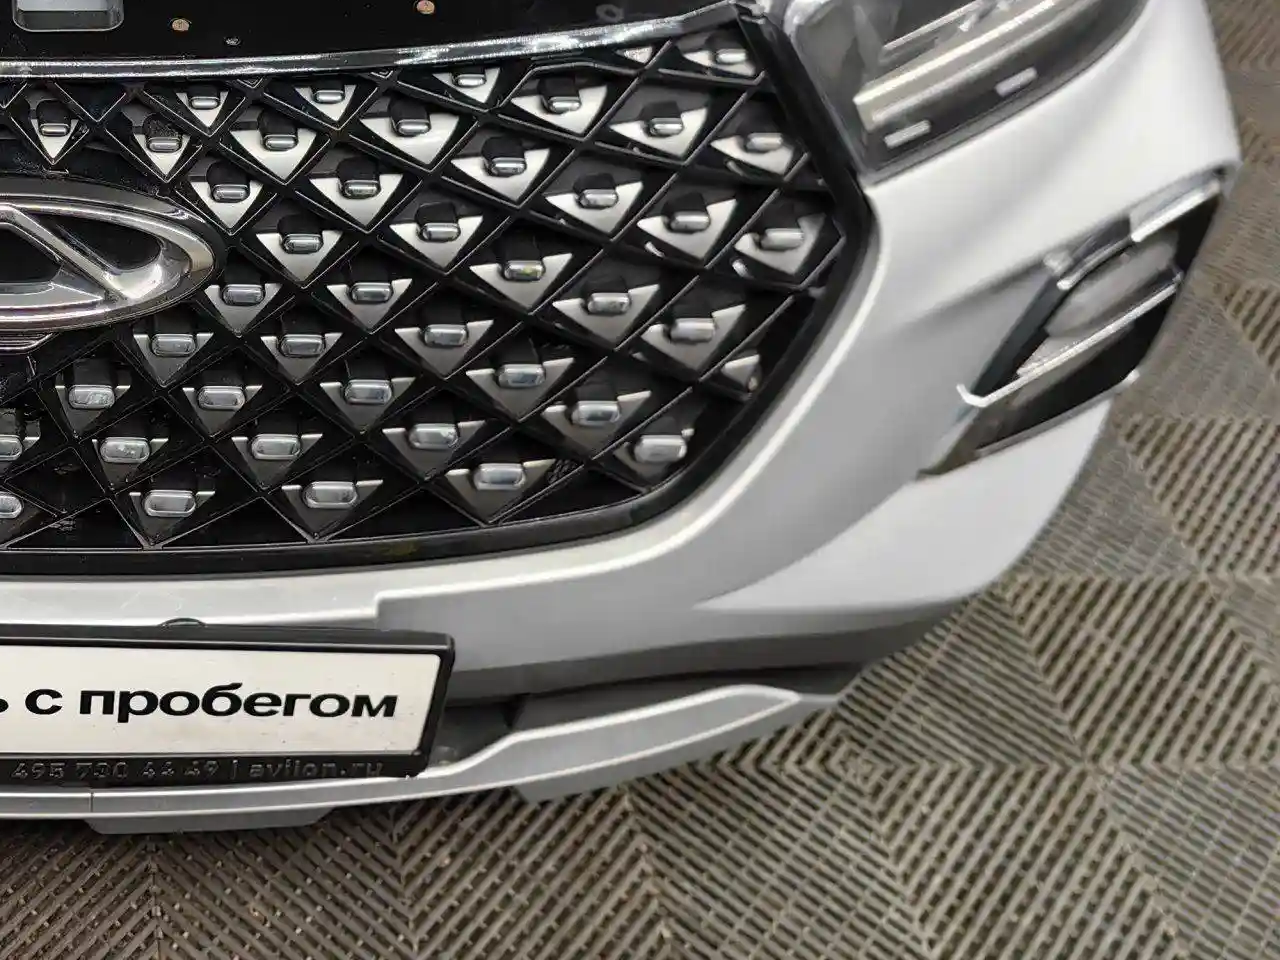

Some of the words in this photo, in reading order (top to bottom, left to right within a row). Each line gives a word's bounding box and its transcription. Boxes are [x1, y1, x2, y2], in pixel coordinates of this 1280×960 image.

[24, 688, 63, 716] с
[80, 683, 398, 724] пробегом
[11, 761, 66, 779] 495
